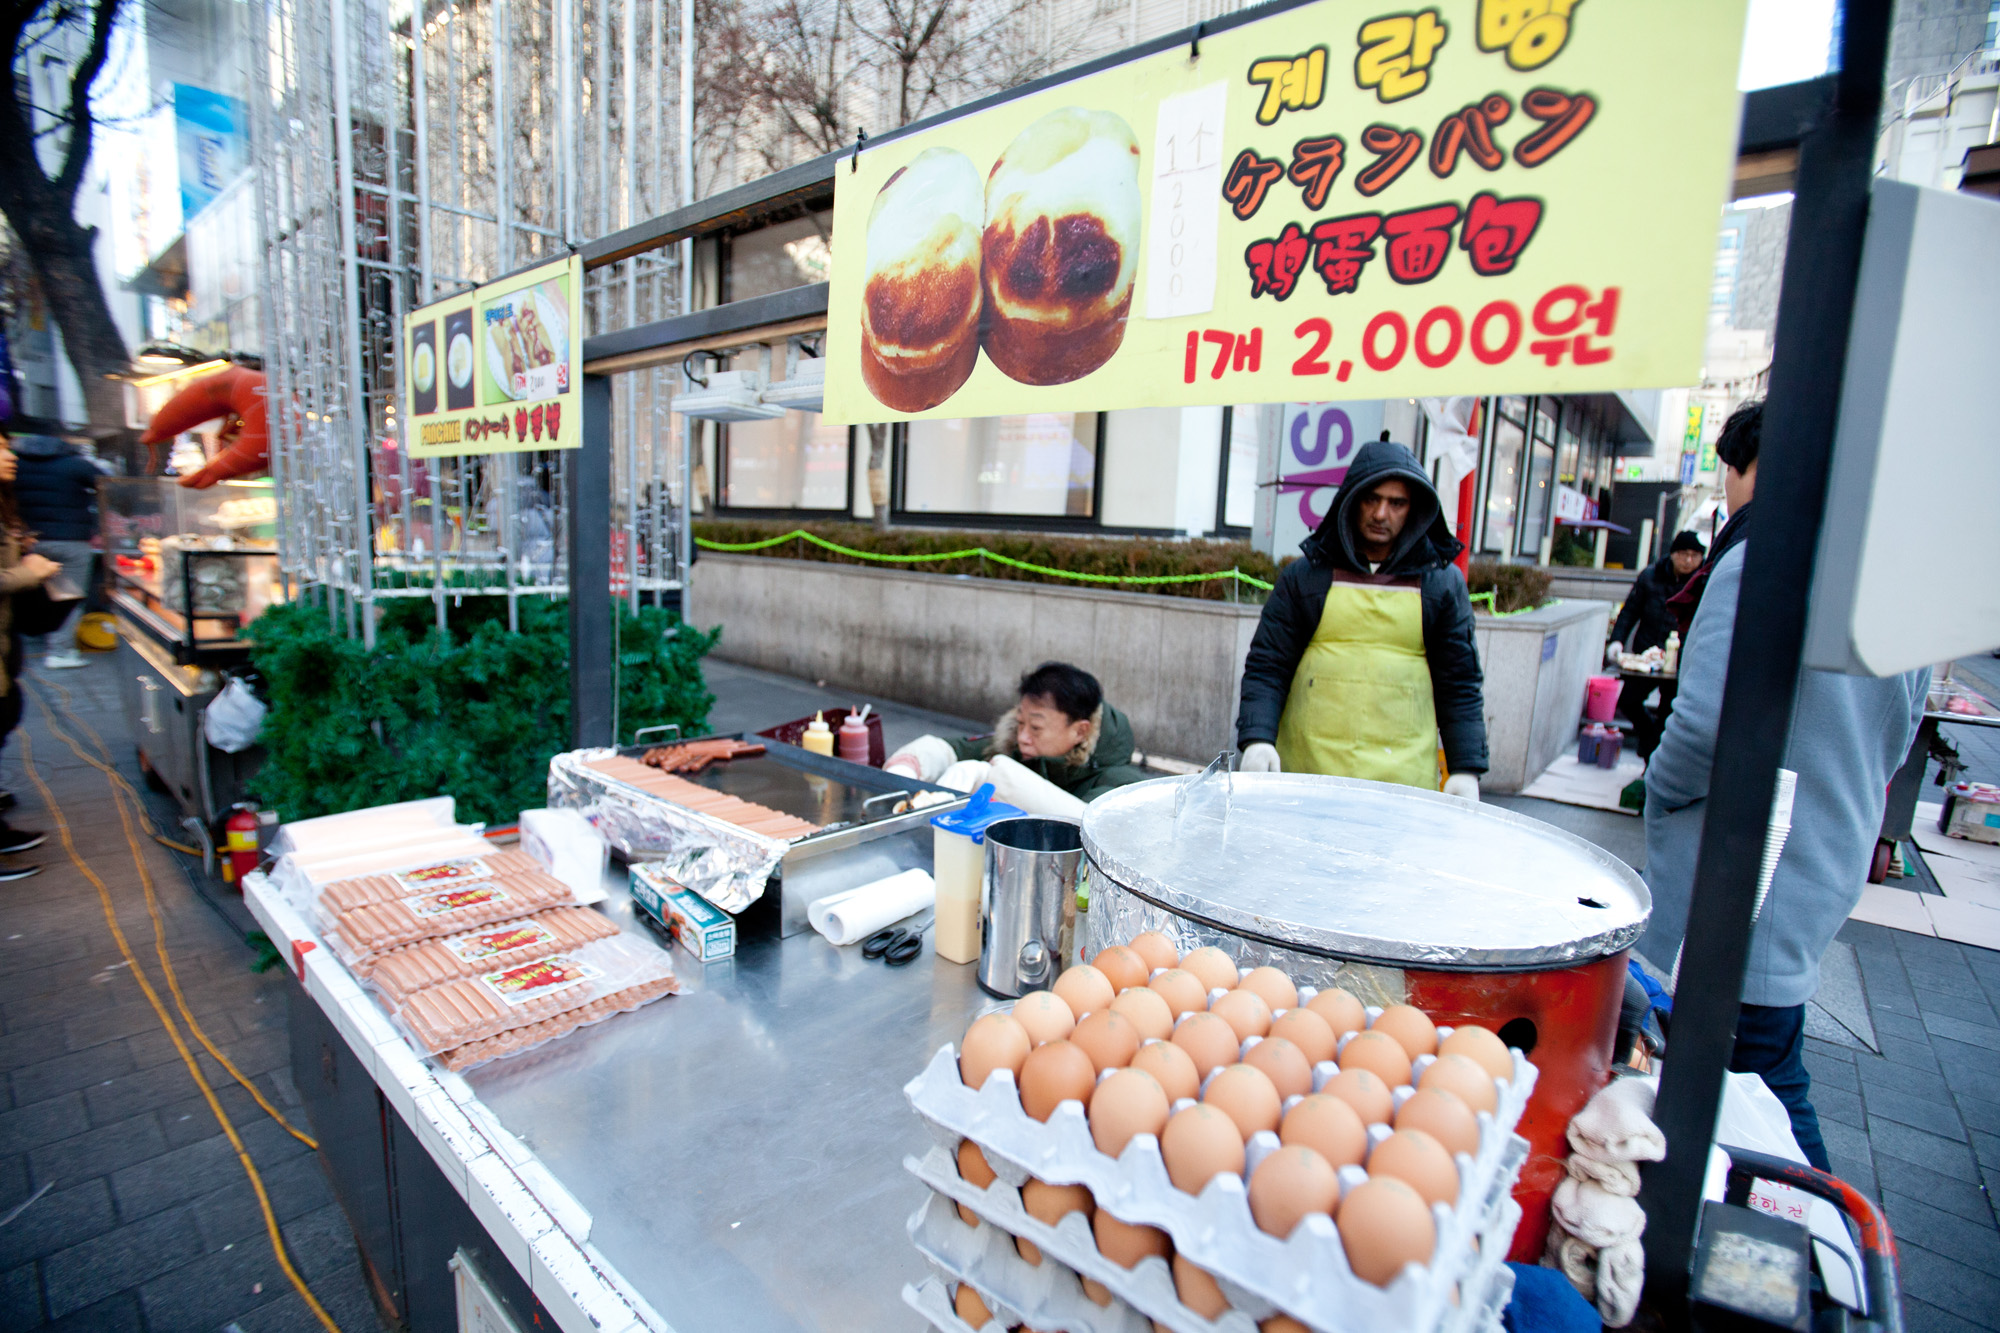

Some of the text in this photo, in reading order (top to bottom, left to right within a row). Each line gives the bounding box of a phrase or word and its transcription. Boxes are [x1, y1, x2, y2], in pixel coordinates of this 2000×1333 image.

[1223, 86, 1599, 221] ケランパン
[1245, 190, 1545, 301] 鸡蛋面包
[1184, 284, 1622, 384] 1개 2,000원
[421, 420, 461, 445] PANCAKE
